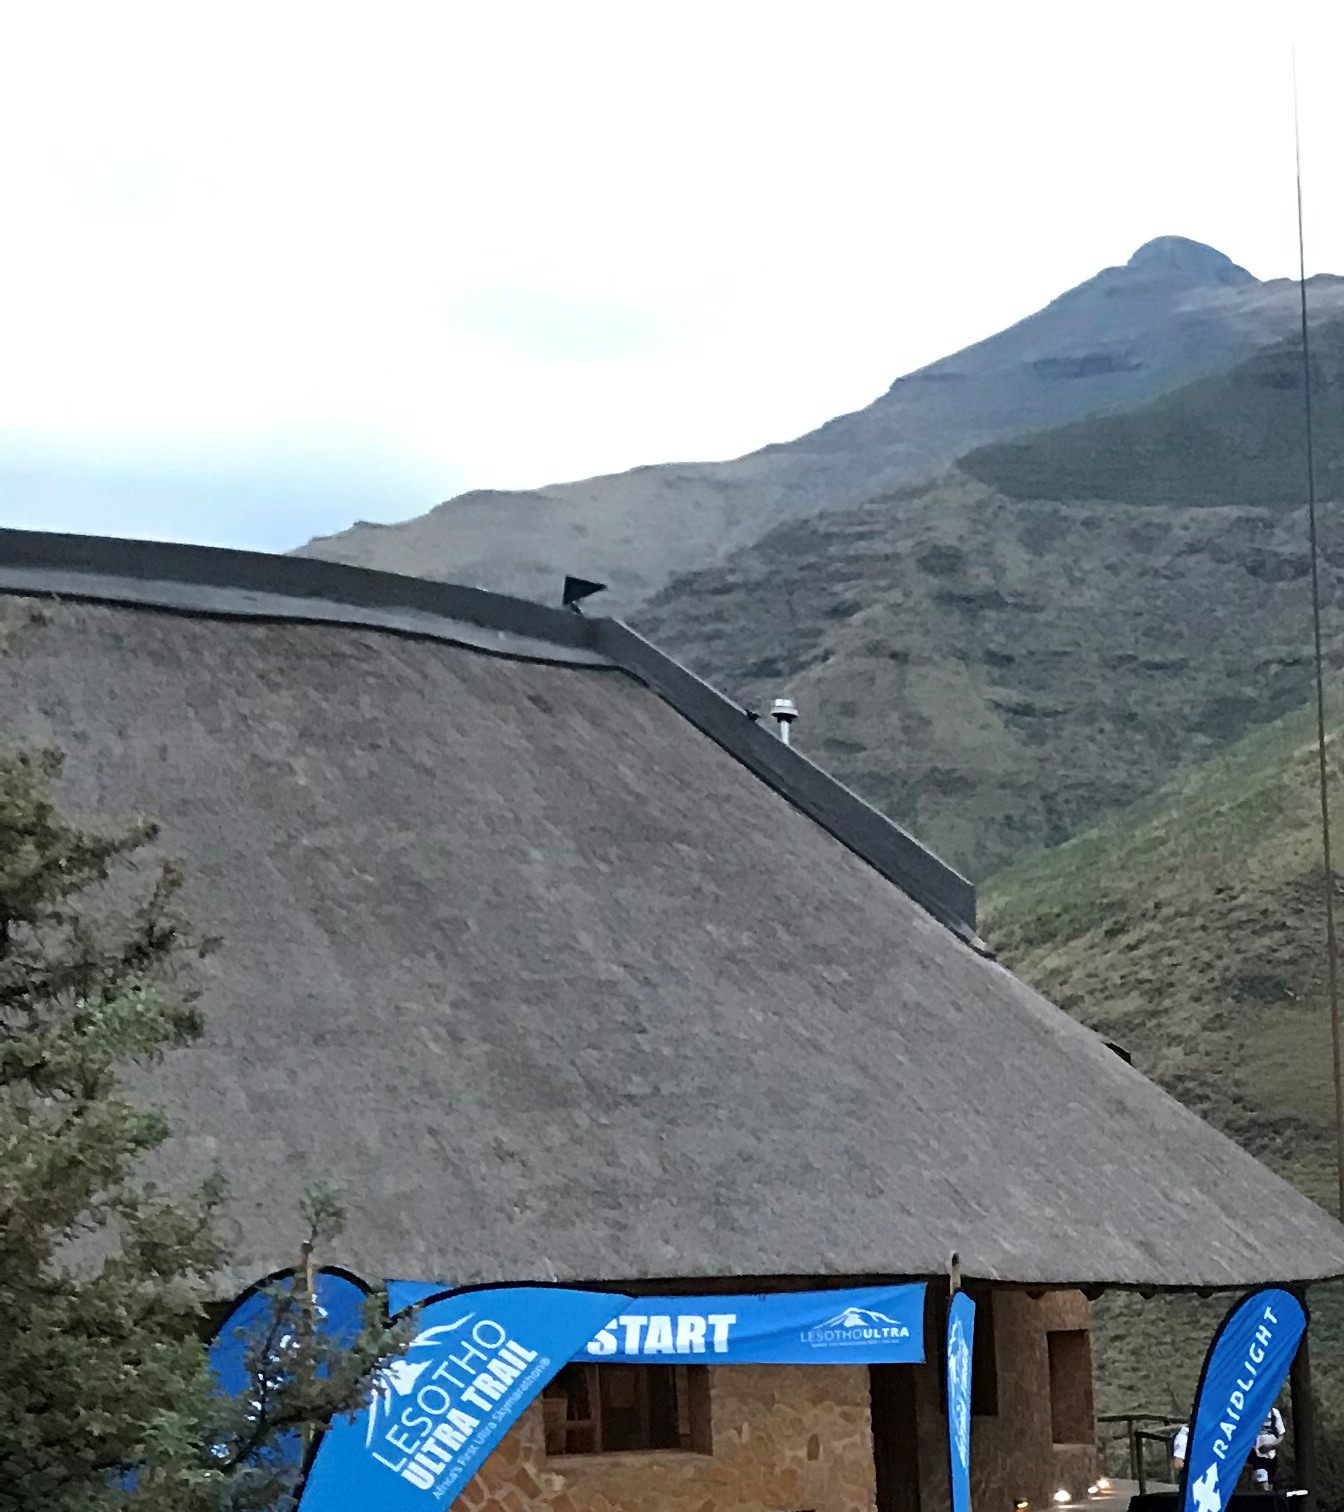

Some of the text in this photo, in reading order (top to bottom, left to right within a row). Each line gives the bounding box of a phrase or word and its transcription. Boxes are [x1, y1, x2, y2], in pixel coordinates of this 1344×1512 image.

[372, 1319, 507, 1473] LESOTHO
[587, 1314, 737, 1356] START
[1212, 1306, 1278, 1460] RAIDLIGHT
[401, 1340, 538, 1490] ULTRA TRAIL
